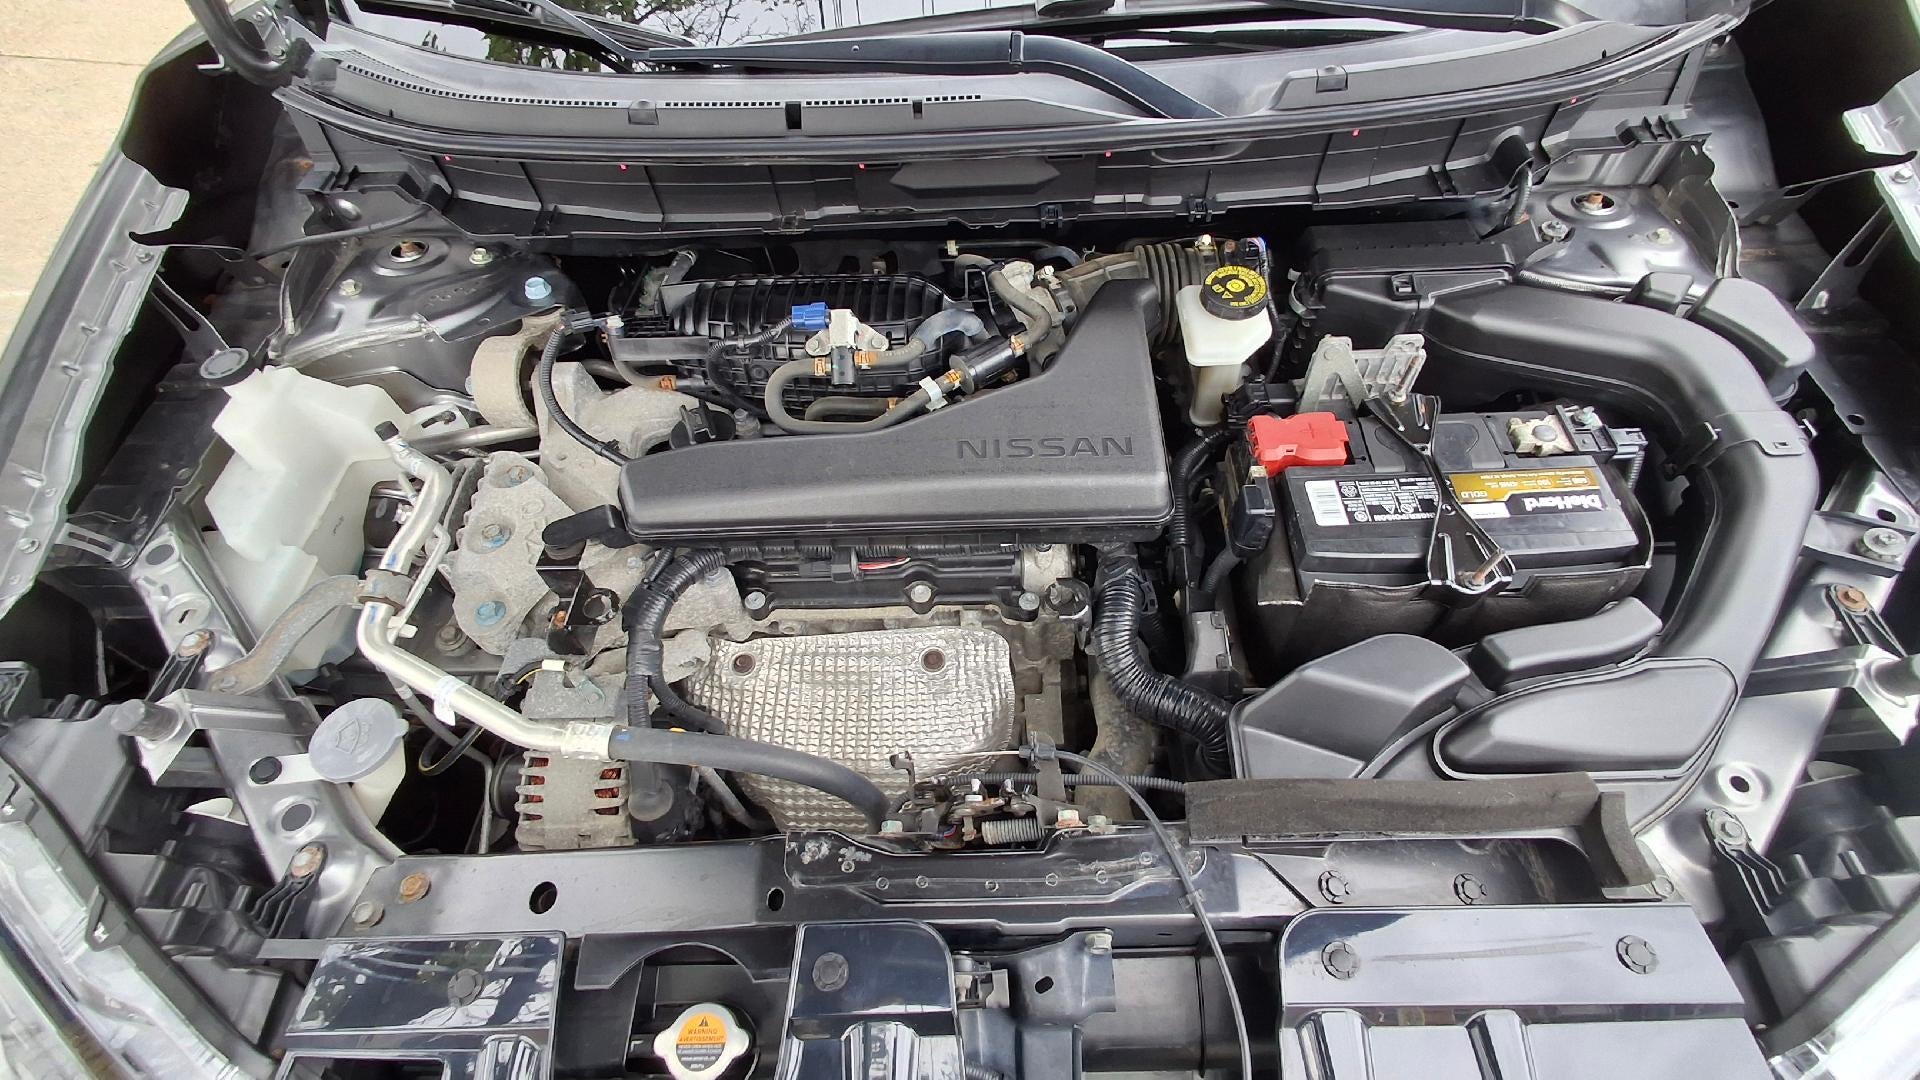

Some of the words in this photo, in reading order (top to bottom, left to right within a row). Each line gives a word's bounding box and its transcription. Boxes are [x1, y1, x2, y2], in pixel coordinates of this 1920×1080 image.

[957, 436, 1134, 459] NISSAN
[1460, 490, 1488, 499] GOLD
[1521, 494, 1604, 512] DieHard
